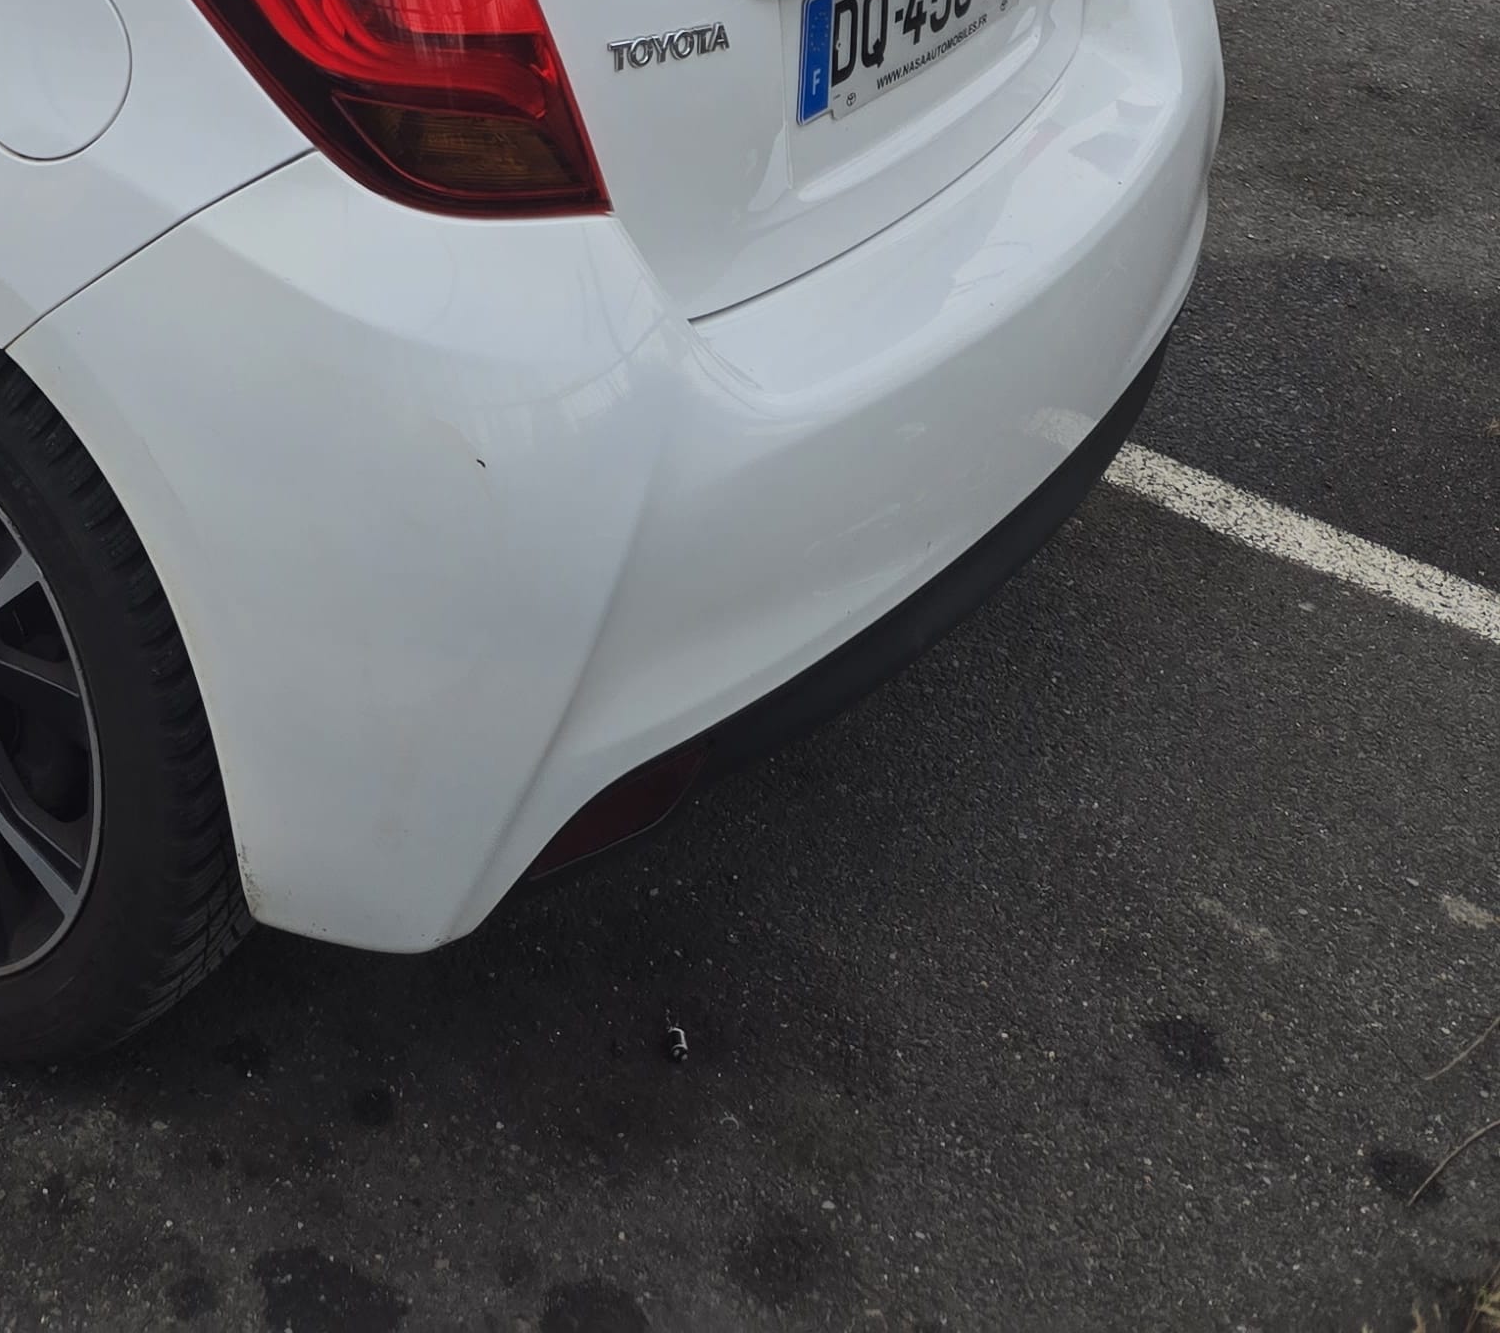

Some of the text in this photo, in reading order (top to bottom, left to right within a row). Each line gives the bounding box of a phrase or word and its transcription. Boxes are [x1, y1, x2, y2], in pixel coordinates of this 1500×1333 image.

[606, 21, 730, 72] TOYOTA
[876, 13, 988, 90] WWW.NASAAUTOMOBILES.FR
[811, 68, 821, 95] F
